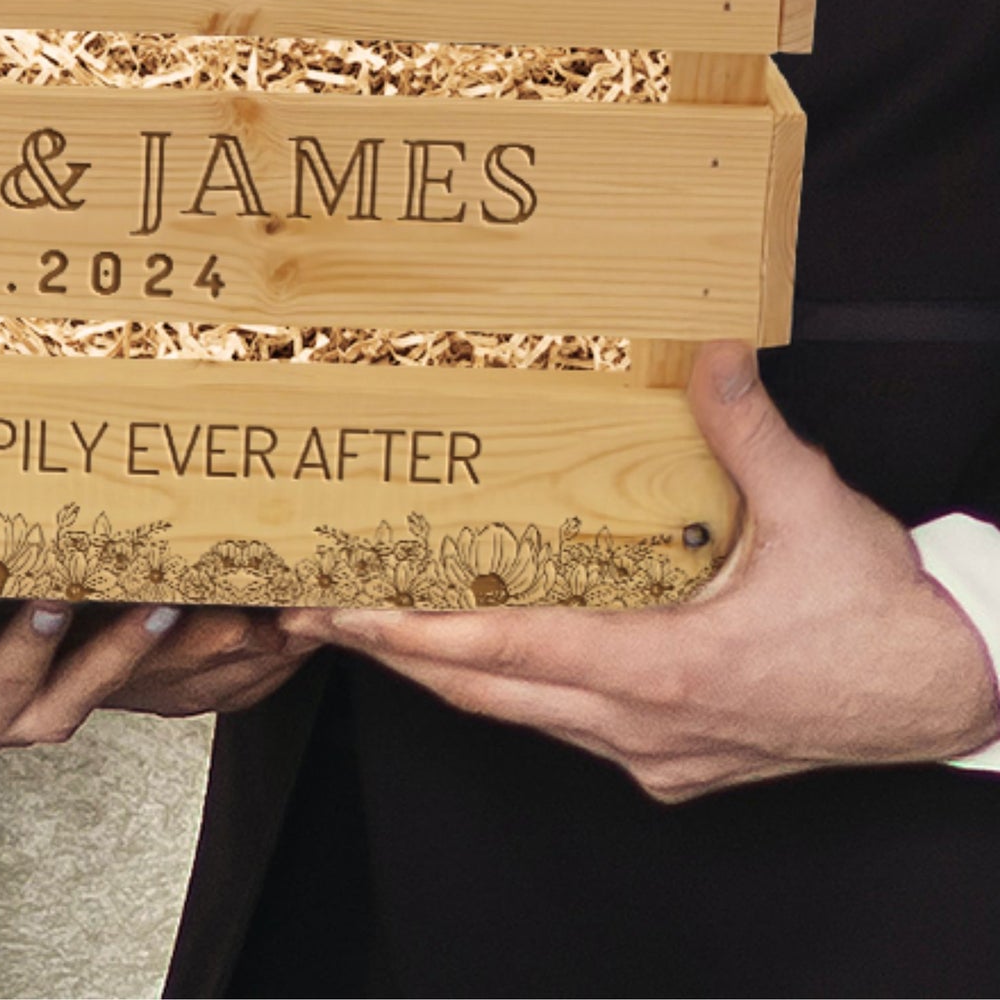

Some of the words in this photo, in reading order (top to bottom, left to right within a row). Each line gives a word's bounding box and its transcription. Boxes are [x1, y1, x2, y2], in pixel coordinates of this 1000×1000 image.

[0, 127, 92, 211] &
[129, 130, 538, 236] JAMES
[127, 421, 278, 480] EVER
[293, 426, 482, 485] AFTER
